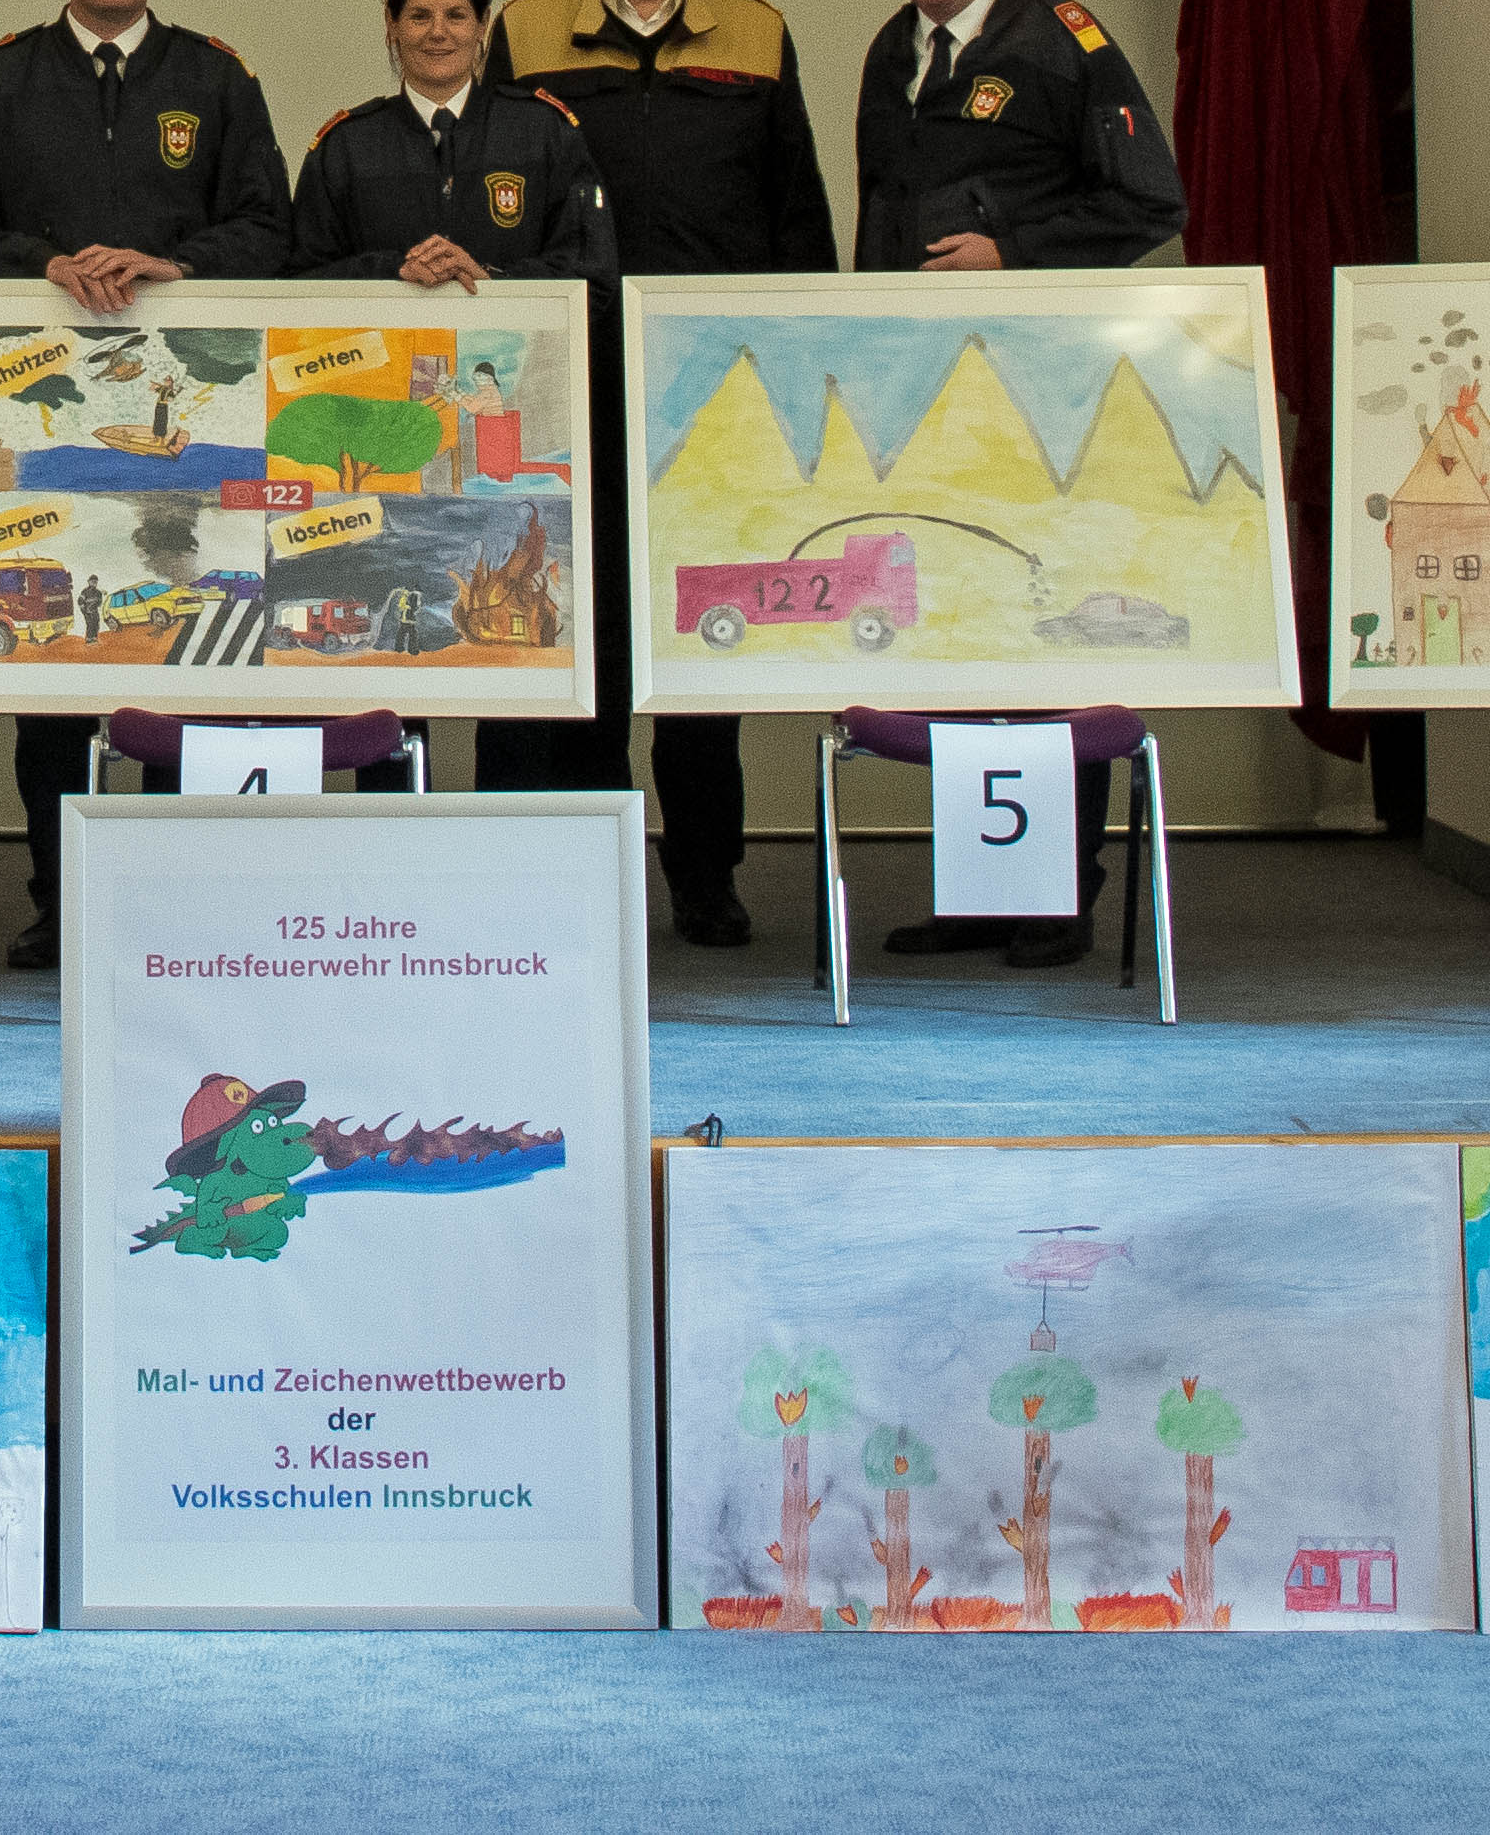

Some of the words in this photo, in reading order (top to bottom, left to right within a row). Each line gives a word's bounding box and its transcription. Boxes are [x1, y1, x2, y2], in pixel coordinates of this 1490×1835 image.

[294, 348, 363, 378] retten
[262, 485, 303, 505] 122
[286, 512, 372, 544] löschen
[981, 770, 1029, 847] 5
[277, 916, 326, 940] 125
[335, 916, 417, 940] Jahre
[146, 953, 391, 978] Berufsfeuerwehr
[401, 952, 548, 977] Innsbruck
[137, 1367, 199, 1393] Mal-
[209, 1368, 265, 1393] und
[274, 1367, 567, 1393] Zeichenwettbewerb
[327, 1407, 376, 1432] der
[275, 1445, 301, 1470] 3.
[310, 1445, 429, 1470] Klassen
[172, 1484, 372, 1509] Volksschulen
[383, 1484, 533, 1509] Innsbruck
